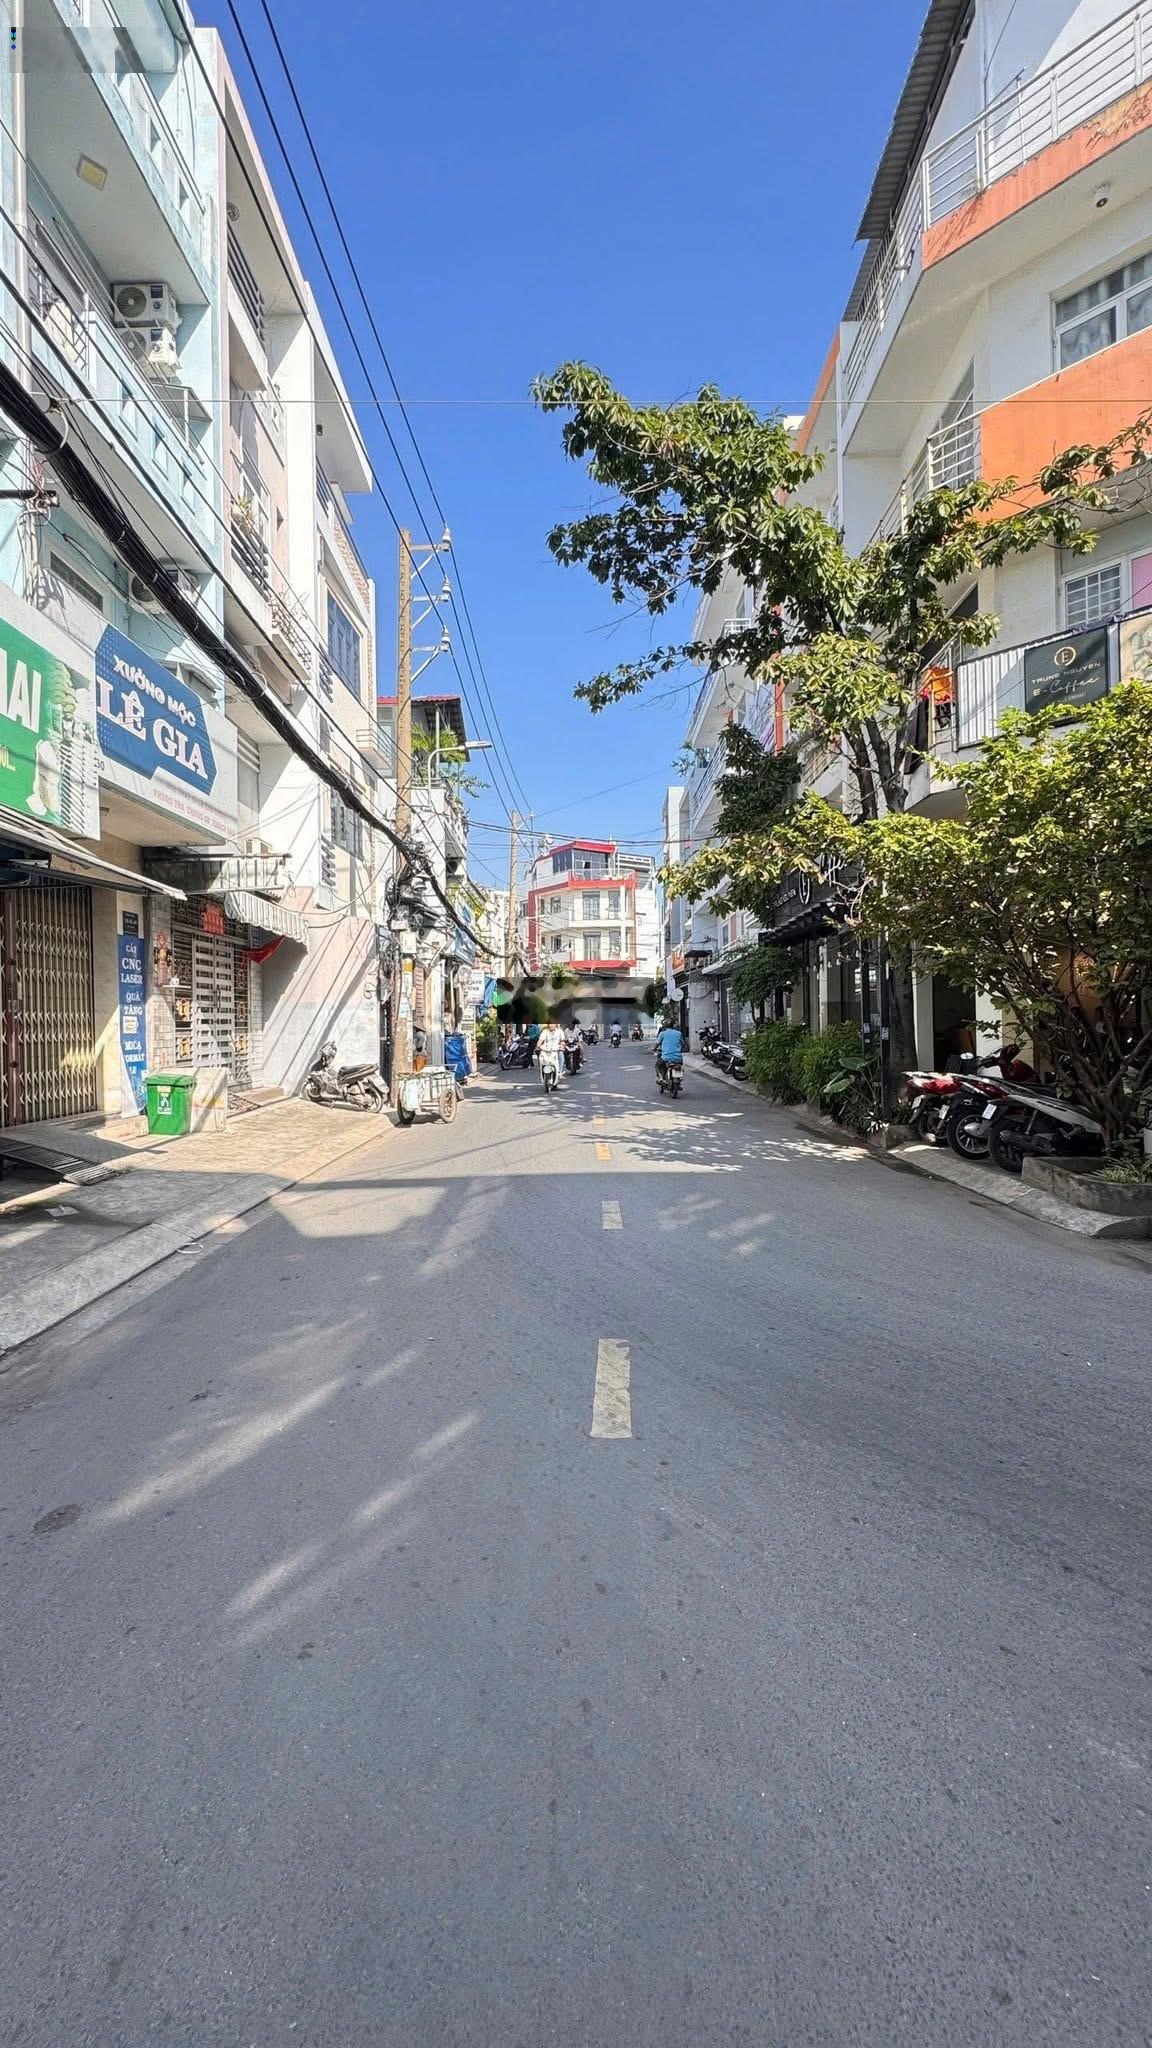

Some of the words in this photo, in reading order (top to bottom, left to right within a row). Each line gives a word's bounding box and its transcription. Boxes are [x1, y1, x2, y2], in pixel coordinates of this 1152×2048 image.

[167, 695, 196, 727] MỘC
[96, 675, 147, 742] LÊ
[152, 718, 208, 780] GIA
[121, 957, 142, 971] CNC
[120, 973, 143, 984] LASER
